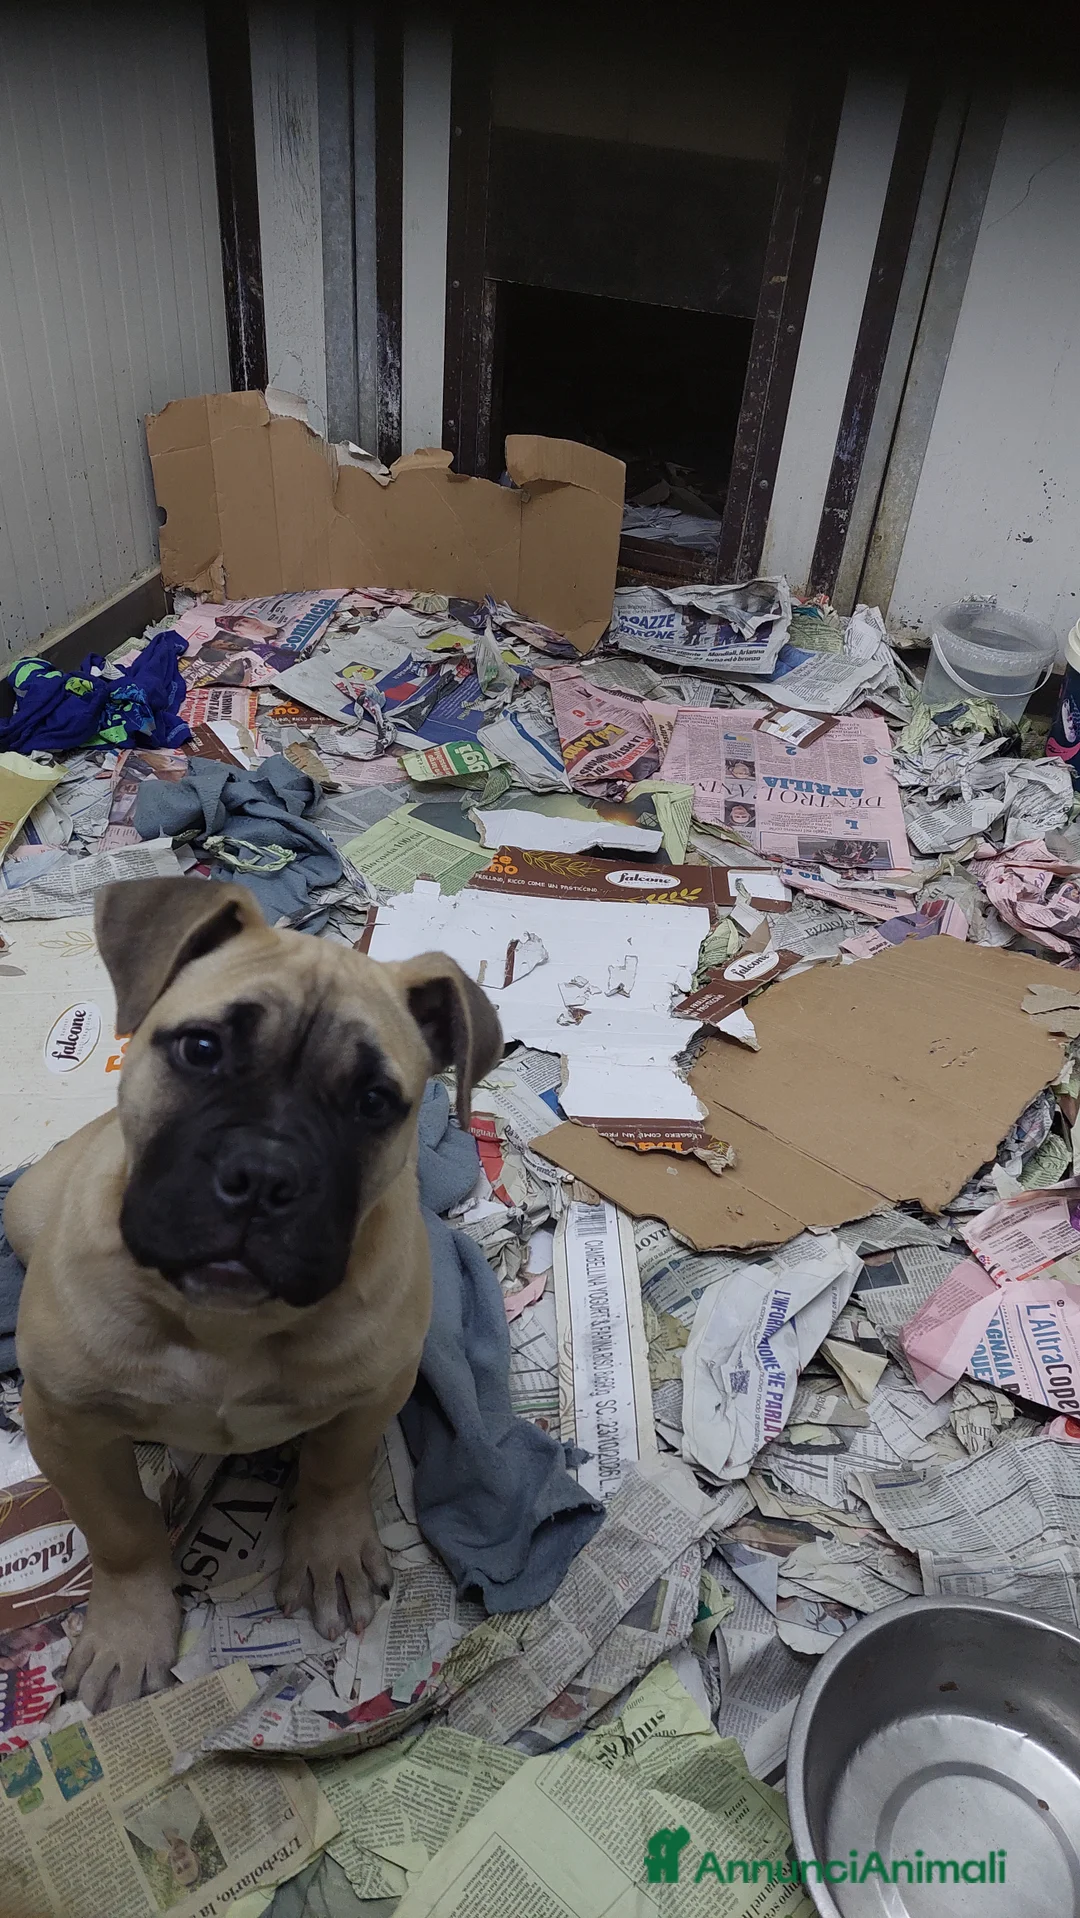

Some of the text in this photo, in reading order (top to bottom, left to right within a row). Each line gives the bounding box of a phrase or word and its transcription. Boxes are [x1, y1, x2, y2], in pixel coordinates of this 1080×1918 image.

[281, 598, 336, 651] comincia
[561, 732, 604, 762] Rom
[763, 776, 864, 798] APRILIA
[780, 790, 886, 809] DENTRO
[474, 873, 505, 884] FROLLINO,
[507, 877, 526, 886] RICCO
[527, 880, 547, 889] COME
[560, 884, 598, 893] PASTICCINO
[617, 871, 672, 886] falcone
[51, 1008, 88, 1062] falcone
[584, 1240, 607, 1287] CIAMBELLINA
[588, 1286, 610, 1319] YOGURT
[590, 1325, 612, 1352] FARINA
[592, 1352, 614, 1370] RISO
[763, 1393, 786, 1438] PARLA
[217, 1836, 303, 1907] L'Erbolario,
